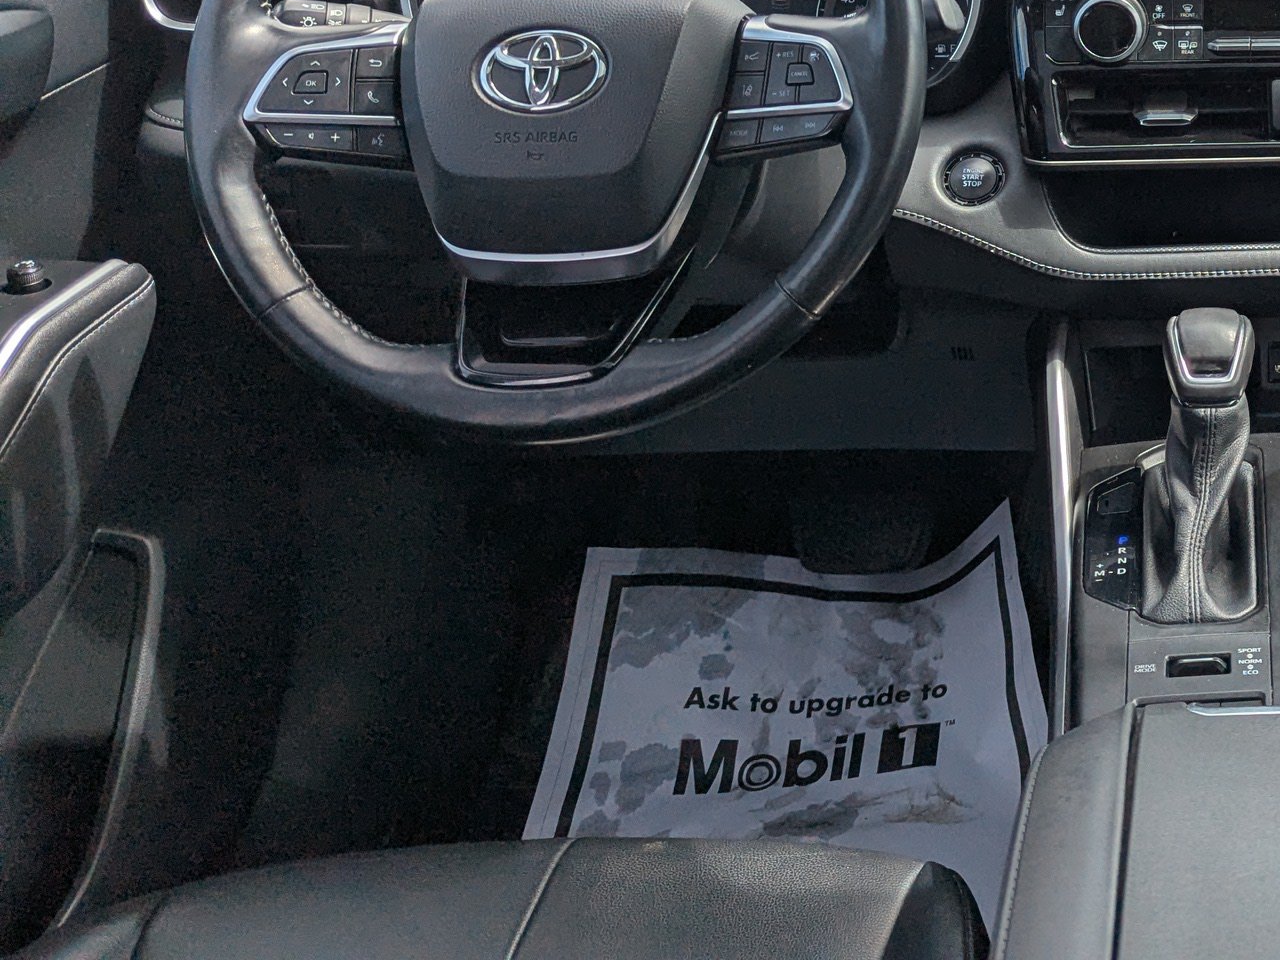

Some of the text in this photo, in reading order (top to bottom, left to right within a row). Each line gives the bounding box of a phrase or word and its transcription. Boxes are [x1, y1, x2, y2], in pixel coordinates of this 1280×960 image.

[494, 131, 578, 144] SRS AIRBAG
[1118, 536, 1129, 545] P
[1117, 567, 1127, 575] D
[683, 683, 948, 719] Ask to upgrade to
[672, 731, 867, 796] Mobil
